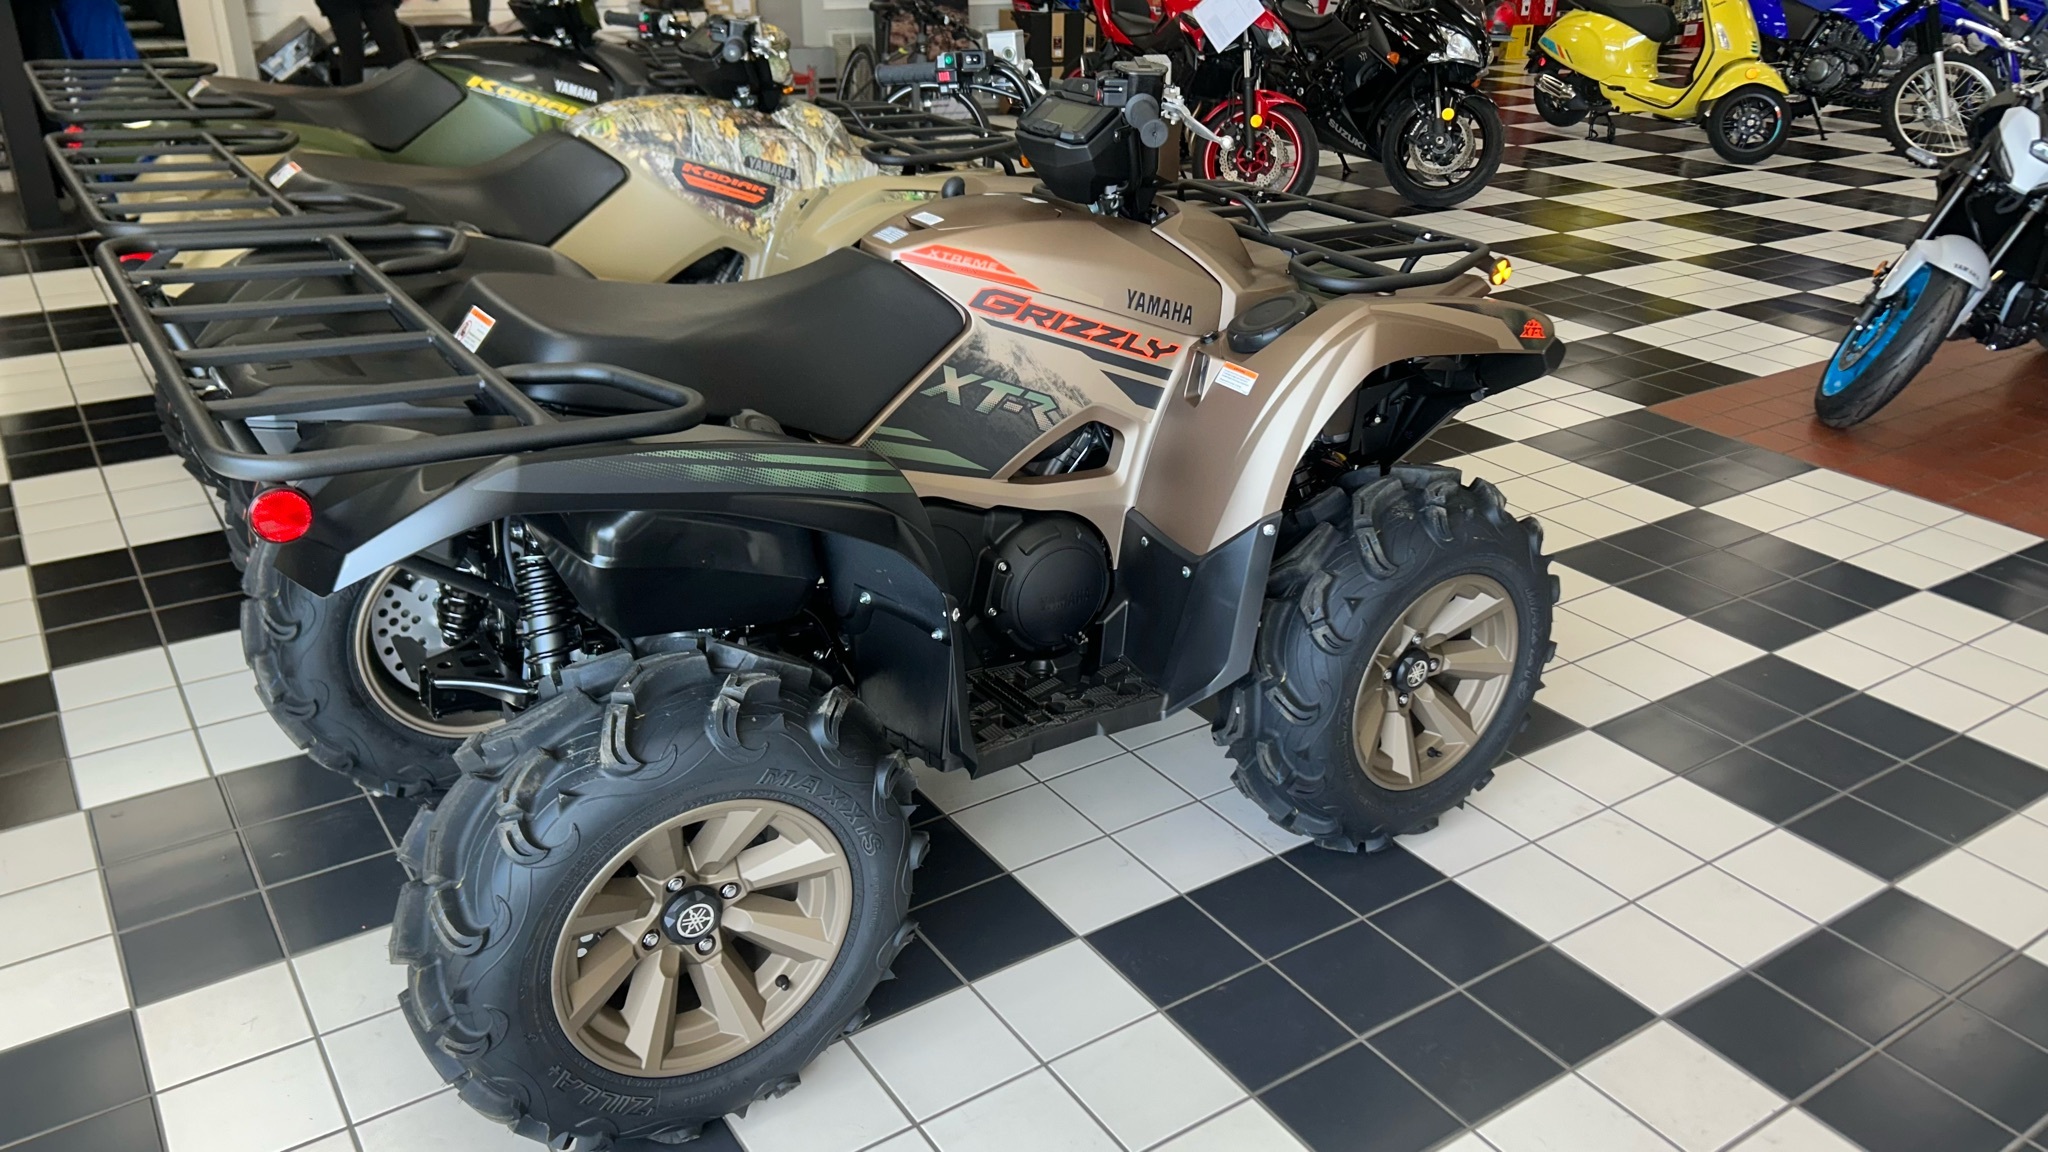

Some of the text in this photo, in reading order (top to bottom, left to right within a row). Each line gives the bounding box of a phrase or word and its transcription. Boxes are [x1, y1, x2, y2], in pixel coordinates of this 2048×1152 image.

[553, 79, 598, 103] YAMAHA
[1328, 118, 1367, 151] SUZUKI
[682, 162, 768, 195] KODIAK
[748, 158, 793, 180] YAMAHA
[928, 249, 1000, 272] XTREME
[1127, 288, 1193, 325] YAMAHA
[969, 287, 1182, 361] GRIZZLY
[755, 767, 884, 857] MAXXIS
